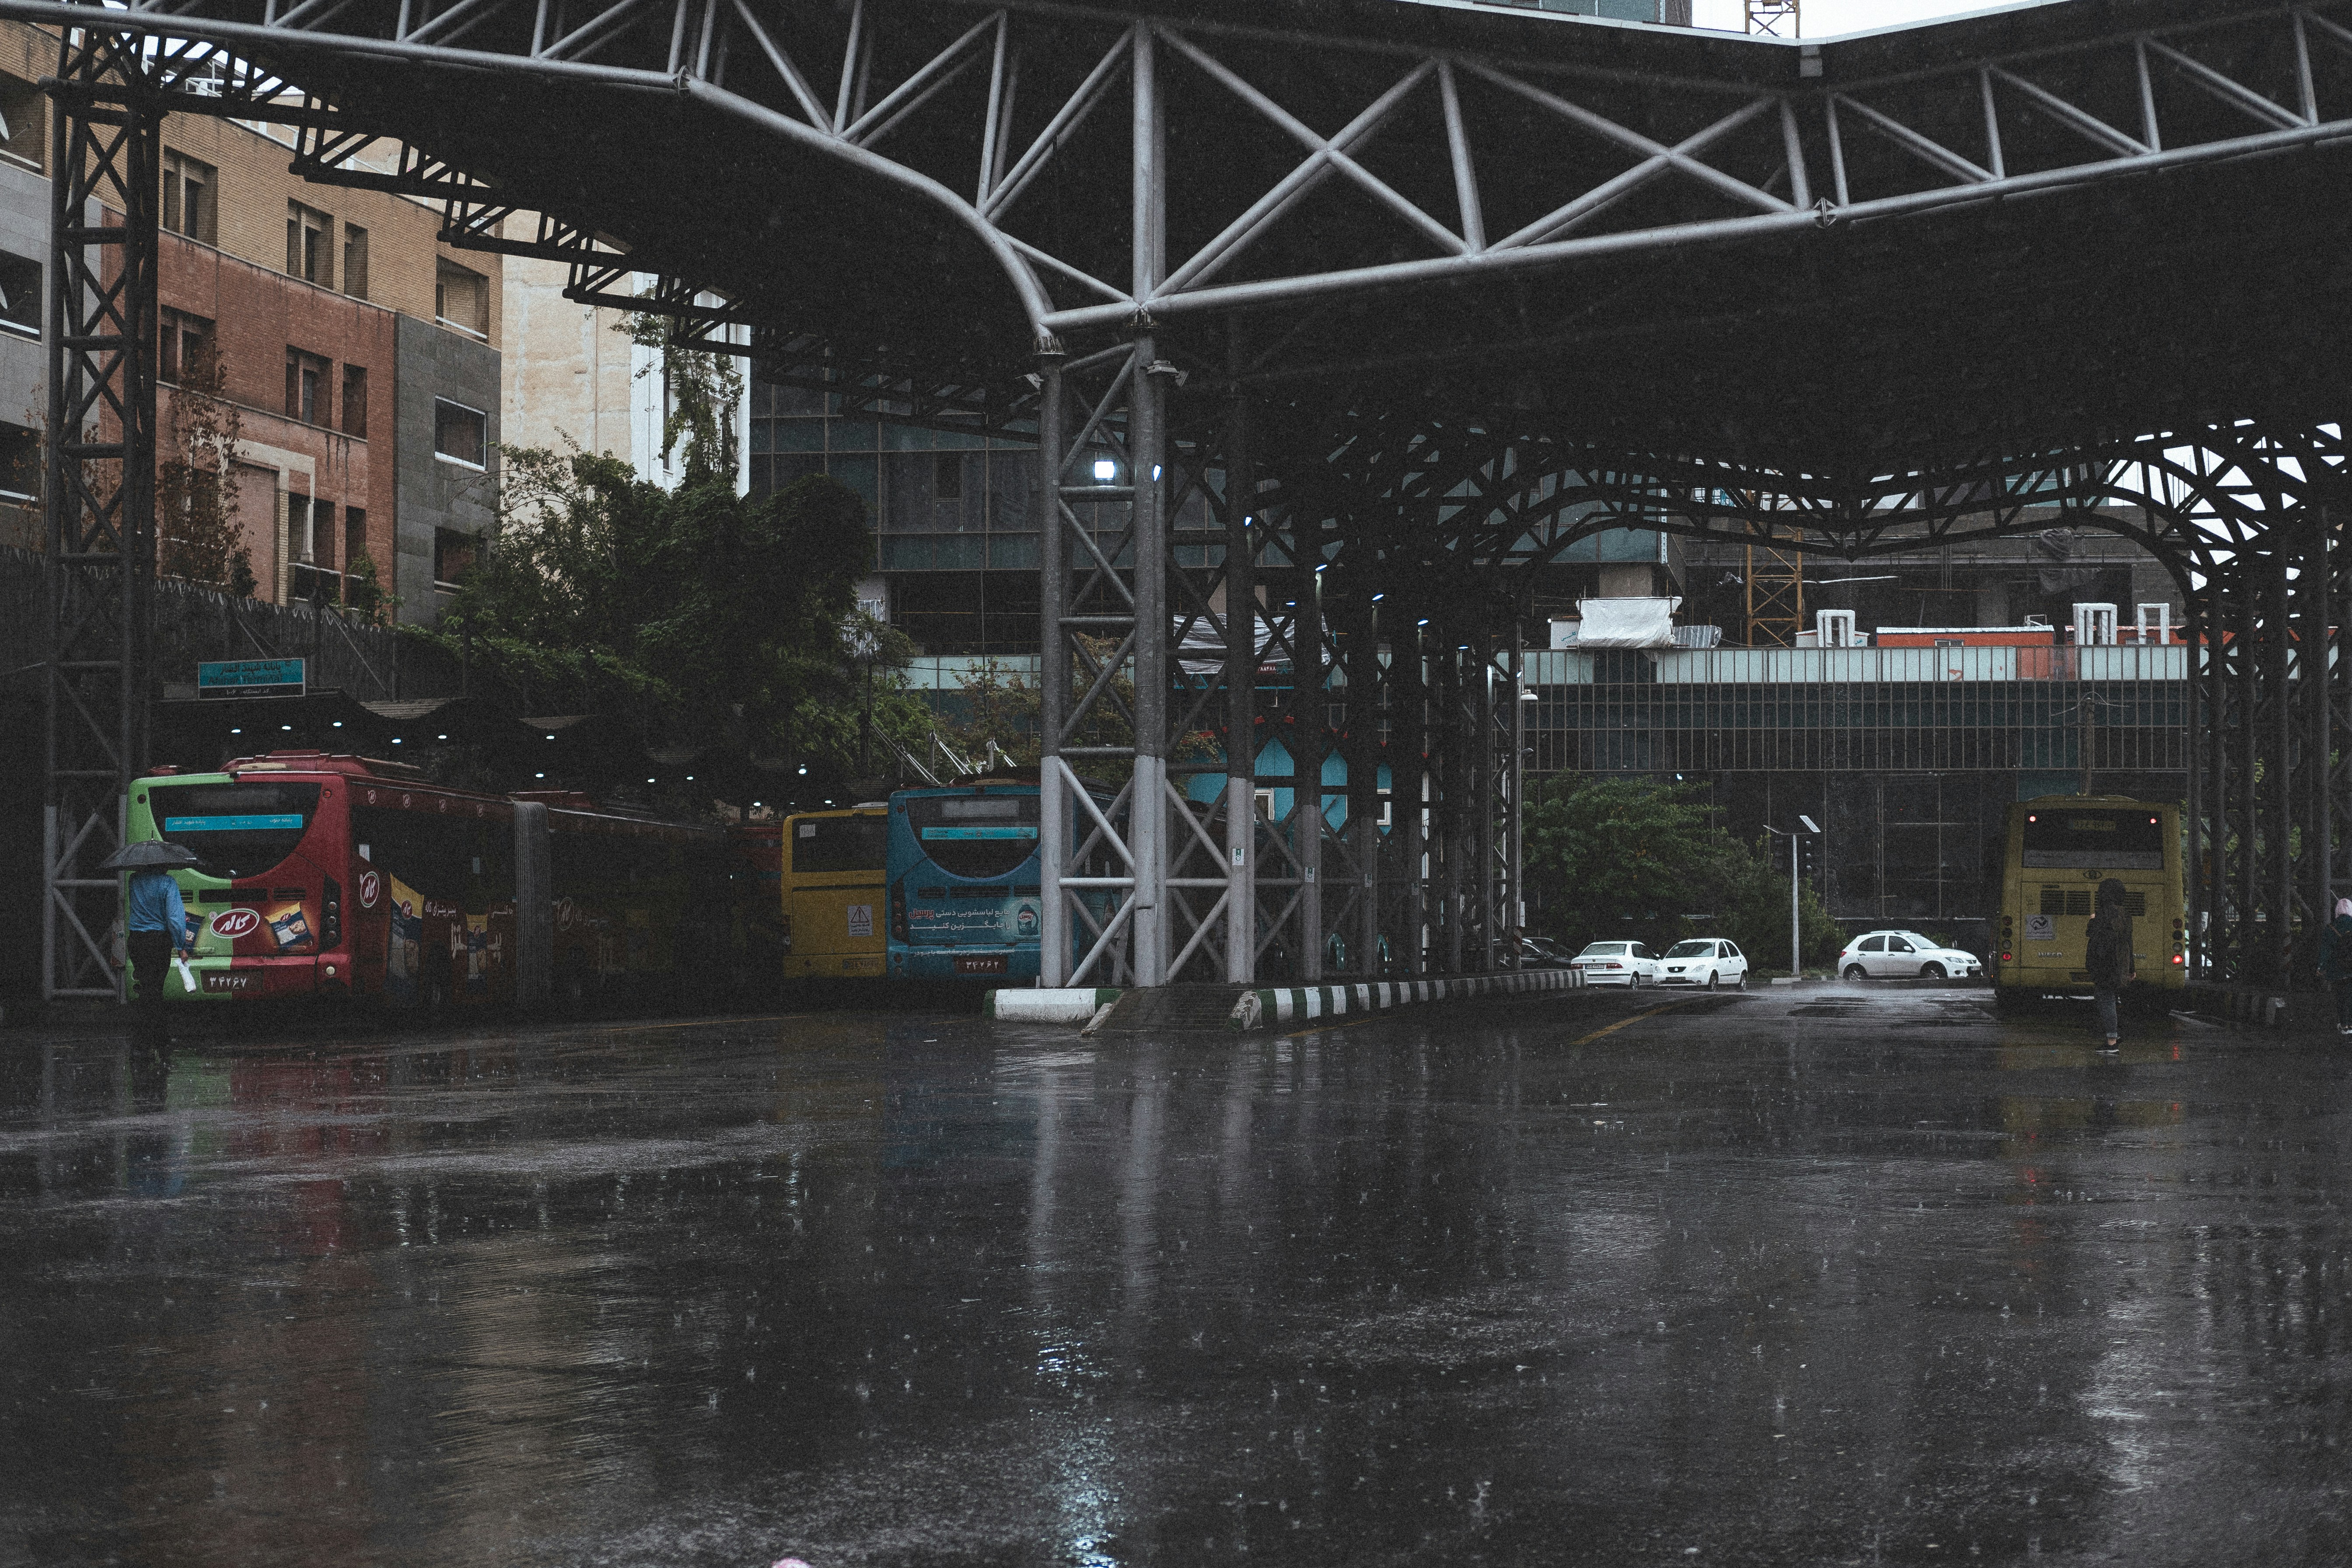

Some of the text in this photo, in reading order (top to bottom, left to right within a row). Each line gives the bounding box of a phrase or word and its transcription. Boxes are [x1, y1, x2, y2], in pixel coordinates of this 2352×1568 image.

[243, 674, 282, 684] Terminal
[909, 908, 1010, 919] مایع لباسشویی دستی پرسیل
[218, 914, 251, 933] کاله
[909, 922, 949, 931] کنید
[210, 976, 247, 988] ۳۴۲۶۷
